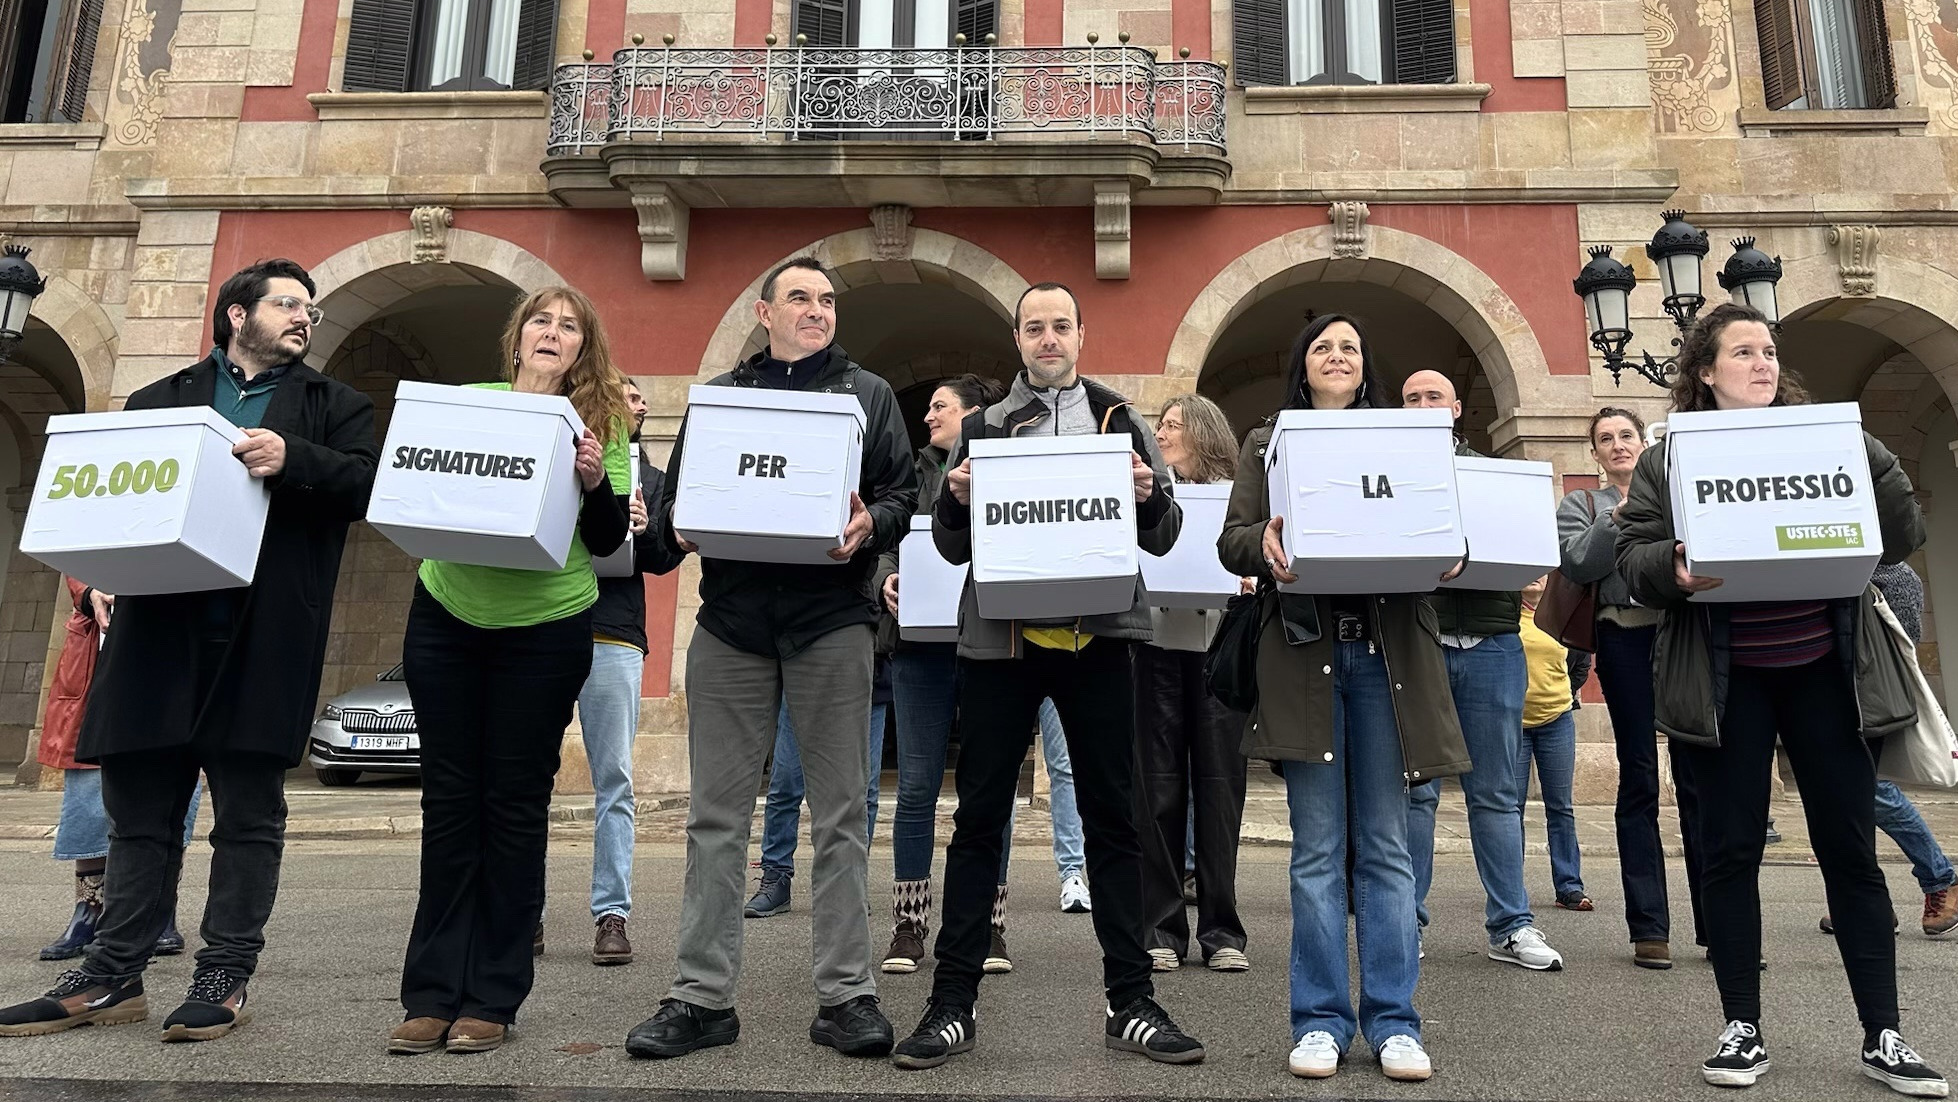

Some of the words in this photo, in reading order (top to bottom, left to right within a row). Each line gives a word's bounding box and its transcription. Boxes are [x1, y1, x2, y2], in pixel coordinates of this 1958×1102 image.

[392, 446, 536, 480] SIGNATURES
[738, 453, 787, 478] PER
[47, 458, 180, 499] 50.000
[1361, 475, 1394, 498] LA
[1695, 466, 1854, 504] PROFESSIÓ
[986, 497, 1122, 526] DIGNIFICAR
[1845, 537, 1859, 545] IAC
[360, 738, 383, 748] 1319
